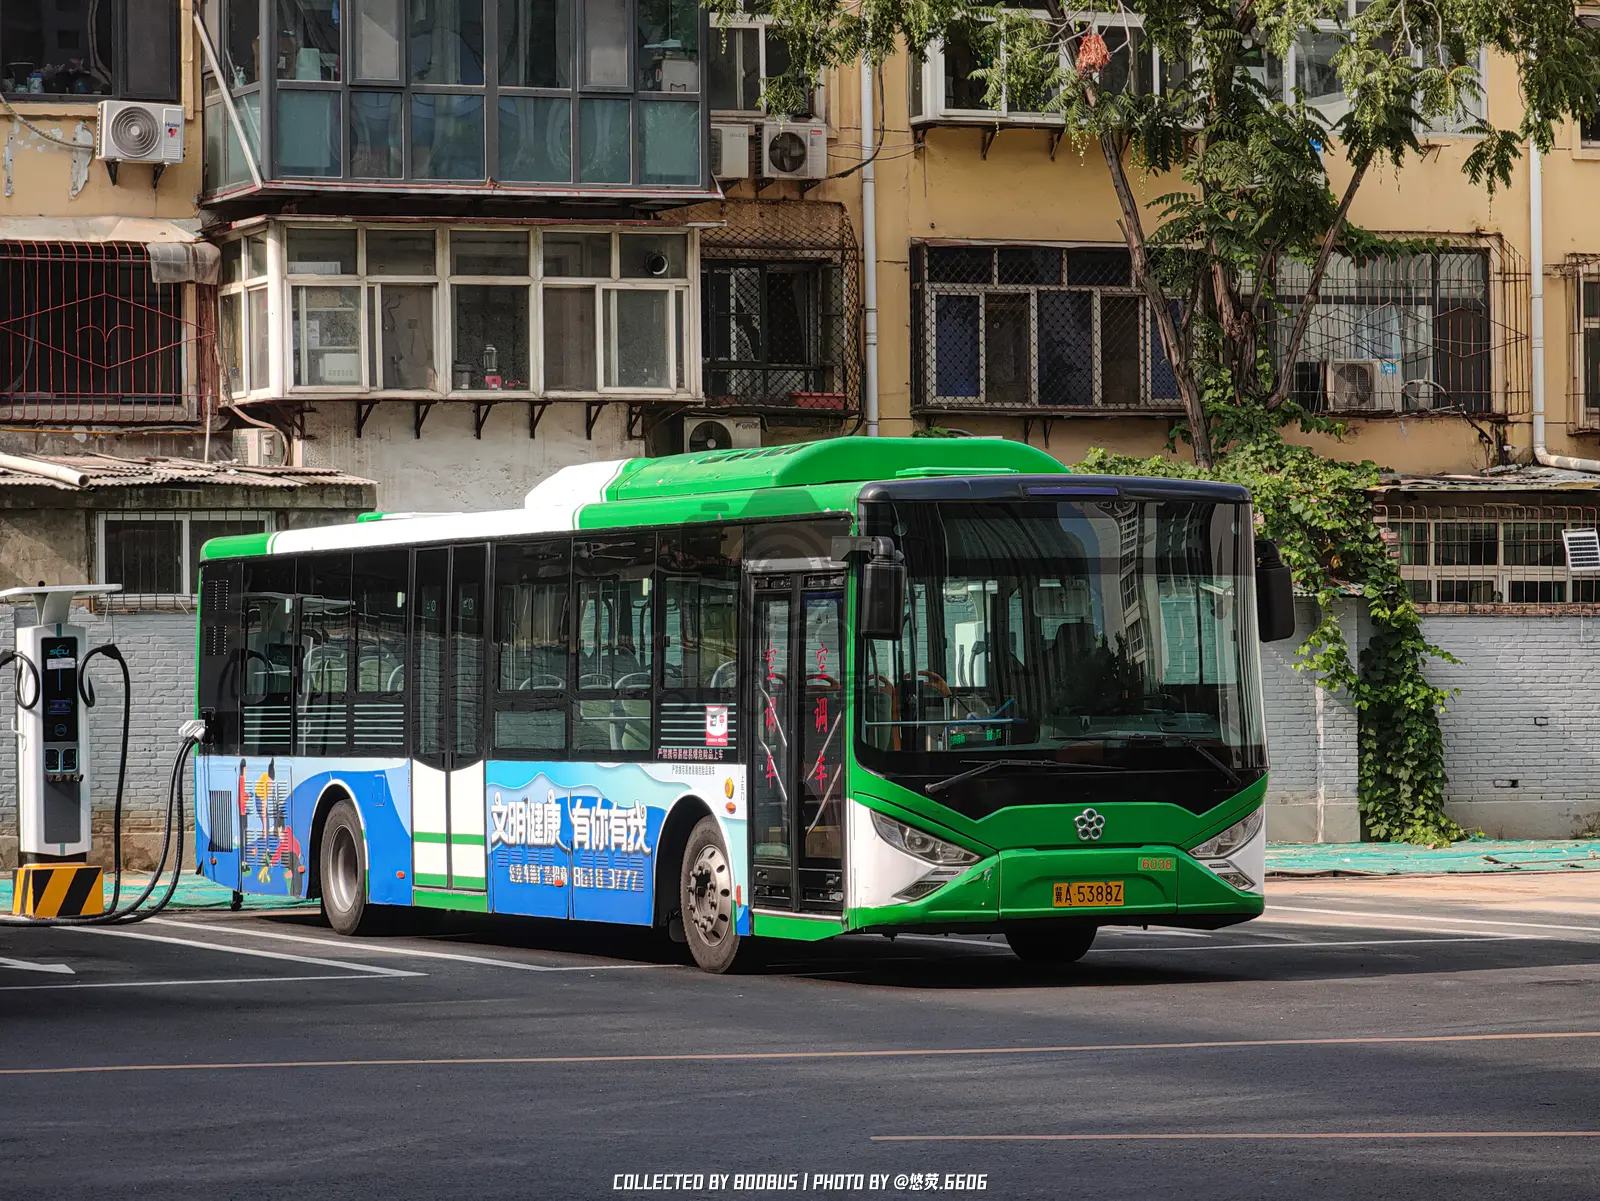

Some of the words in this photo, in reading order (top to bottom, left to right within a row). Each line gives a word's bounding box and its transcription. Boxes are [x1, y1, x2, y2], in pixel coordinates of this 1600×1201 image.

[491, 789, 570, 851] 文明健康
[568, 794, 652, 852] 有你有我
[1142, 858, 1172, 870] 6038
